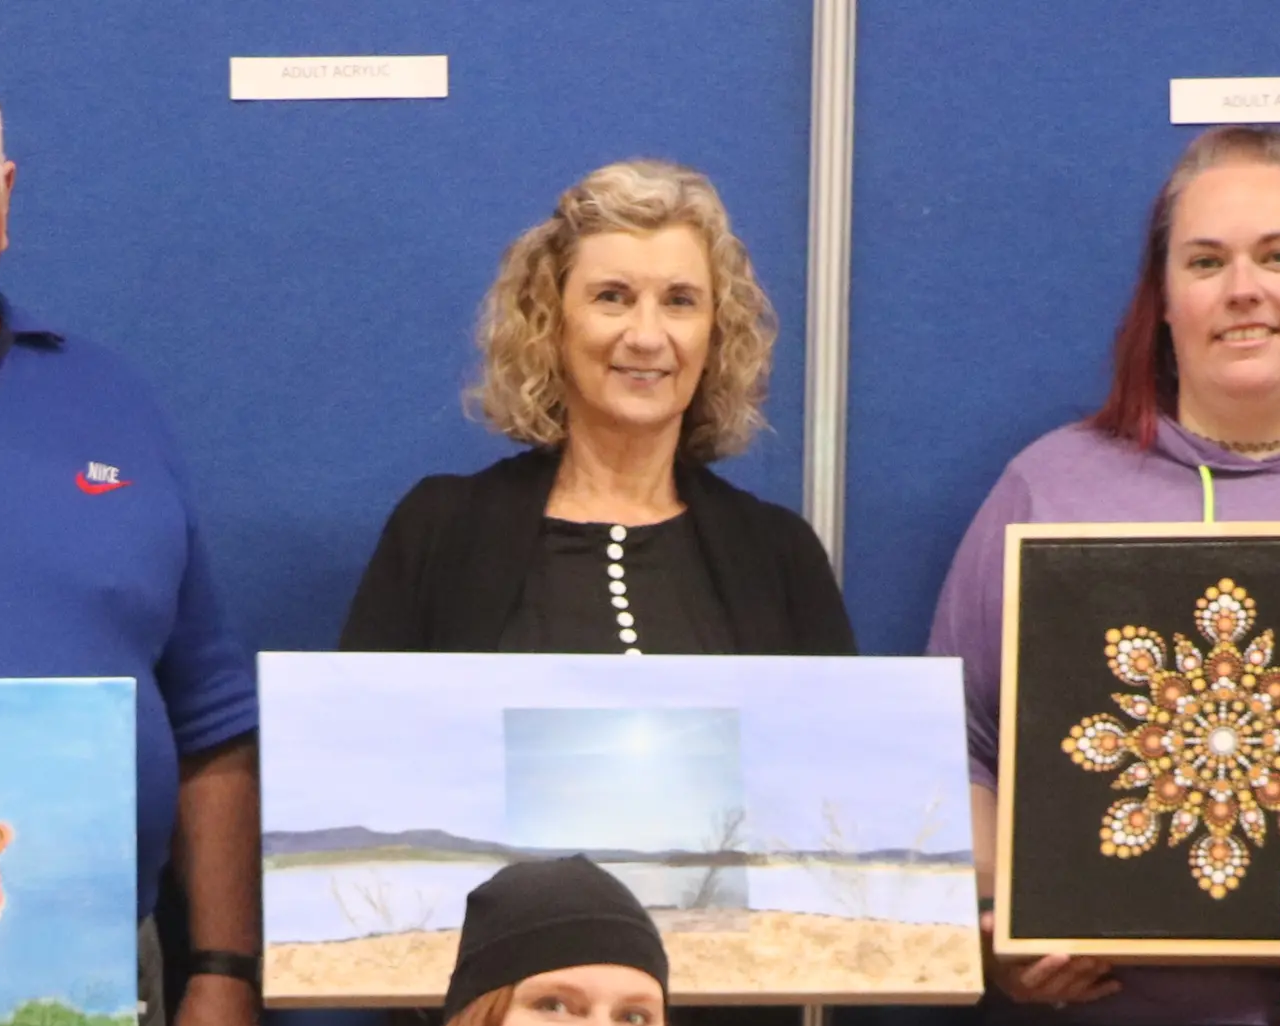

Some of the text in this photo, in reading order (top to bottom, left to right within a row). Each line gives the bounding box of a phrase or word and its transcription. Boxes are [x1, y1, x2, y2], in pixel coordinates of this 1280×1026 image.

[281, 63, 391, 79] ADULT ACRYLIC
[1222, 93, 1271, 107] ADULT
[87, 461, 120, 483] NIKE
